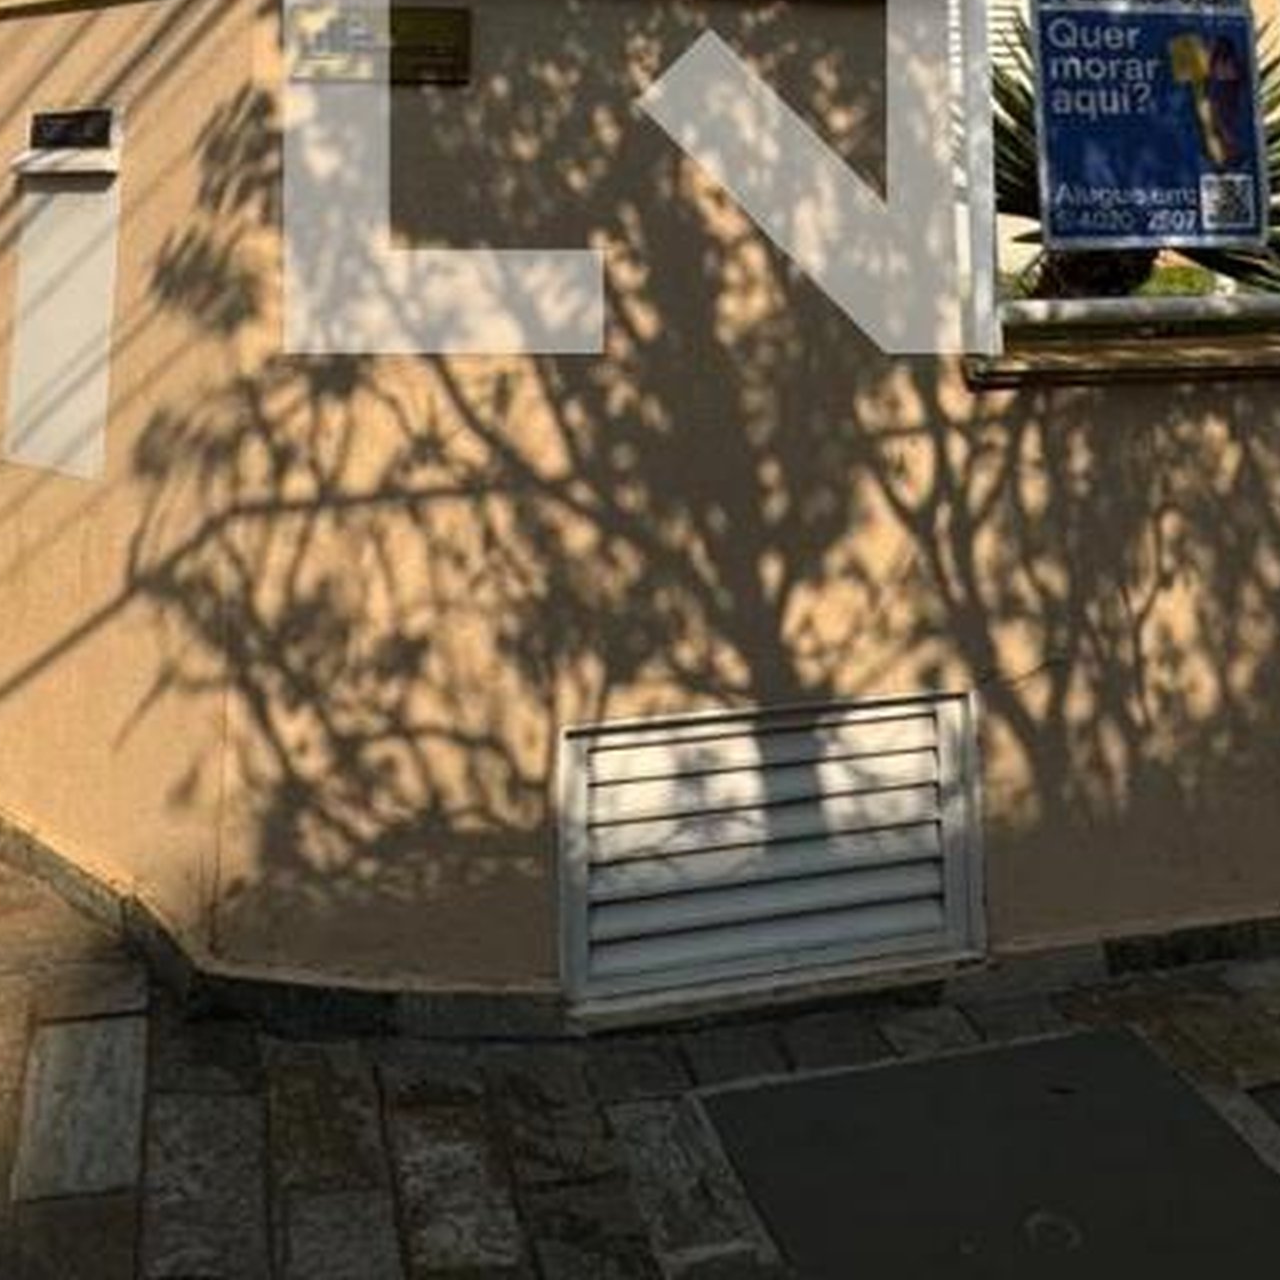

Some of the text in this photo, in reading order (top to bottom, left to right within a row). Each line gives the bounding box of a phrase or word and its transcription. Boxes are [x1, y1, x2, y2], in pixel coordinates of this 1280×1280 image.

[1047, 17, 1141, 51] Quer
[1050, 55, 1160, 82] morar
[1051, 81, 1153, 121] aqui?
